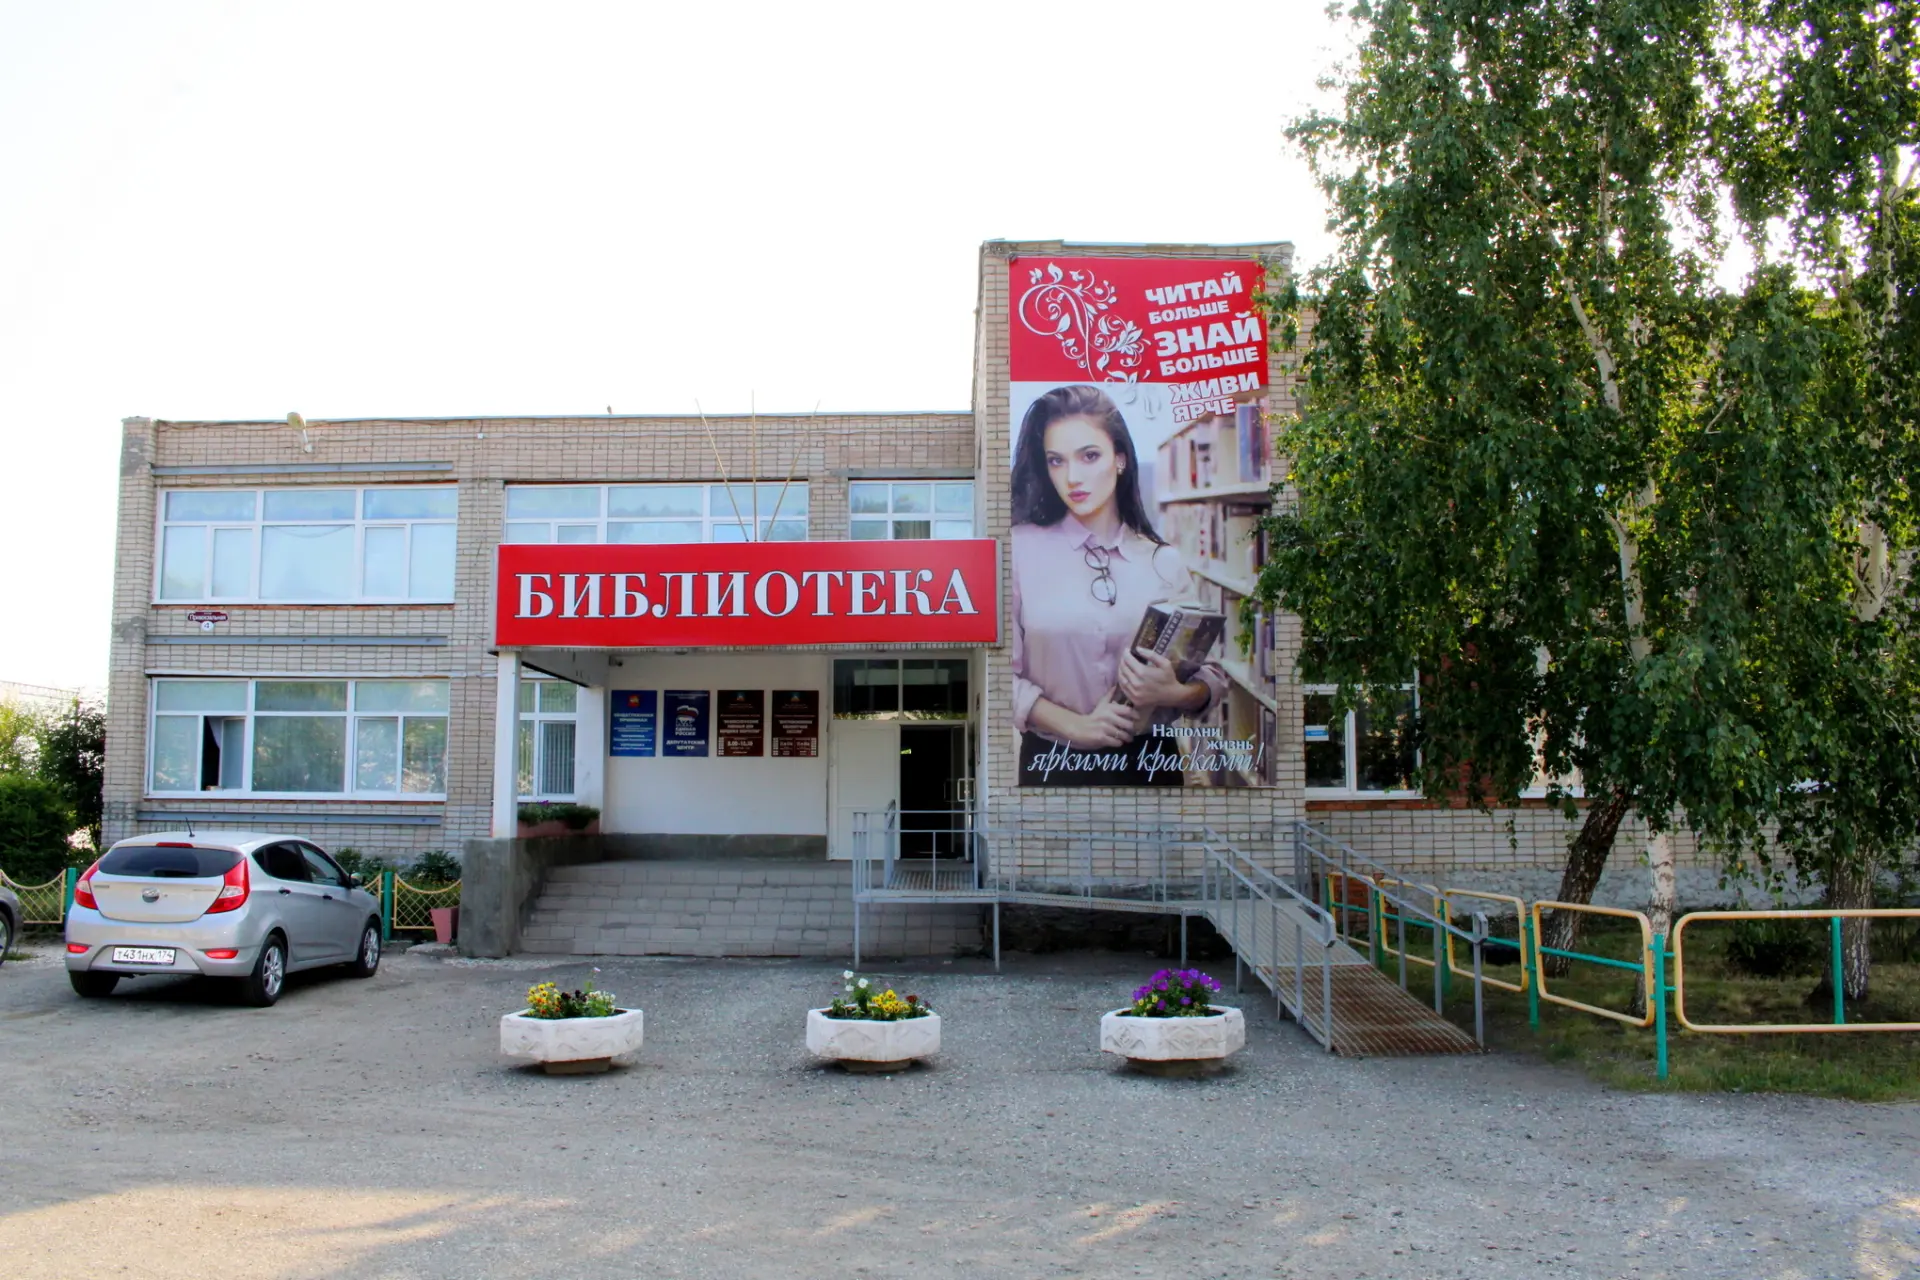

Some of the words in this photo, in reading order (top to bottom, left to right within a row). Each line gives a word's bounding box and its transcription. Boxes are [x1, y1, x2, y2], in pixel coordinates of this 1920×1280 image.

[1145, 271, 1243, 306] ЧИТАЙ
[1148, 300, 1230, 325] БОЛЬШЕ
[1154, 310, 1262, 357] ЗНАЙ
[1159, 346, 1260, 377] БОЛЬШЕ
[1168, 371, 1261, 405] ЖИВИ
[1173, 398, 1236, 424] ЯРЧЕ
[514, 568, 980, 619] БИБЛИОТЕКА
[1152, 723, 1223, 738] Наполни
[1205, 740, 1254, 751] жизнь
[1027, 740, 1129, 782] яркими
[1137, 740, 1265, 782] красками!
